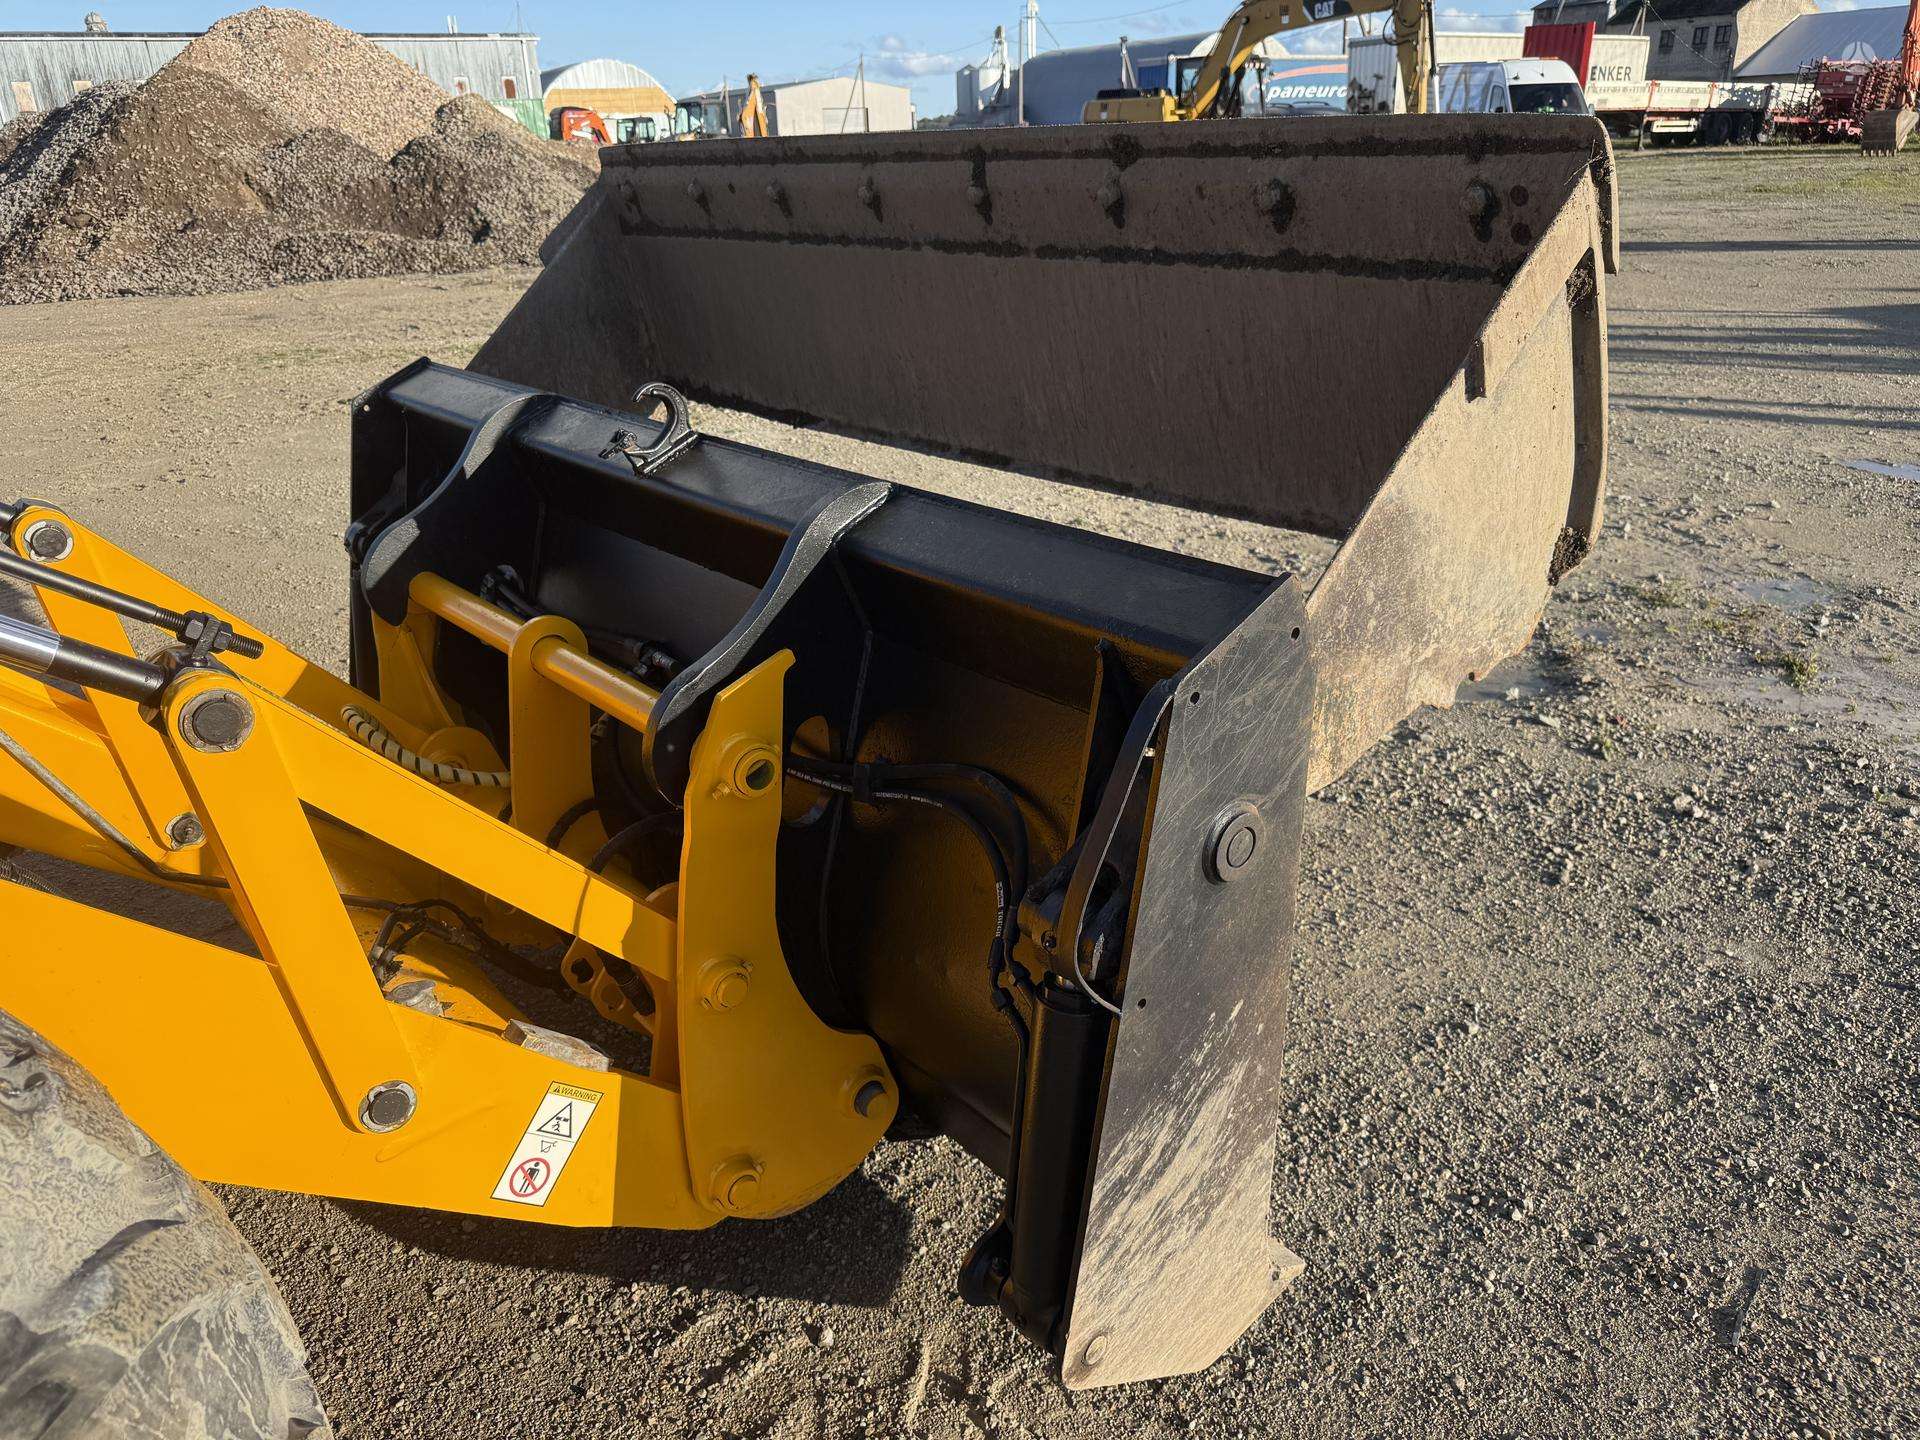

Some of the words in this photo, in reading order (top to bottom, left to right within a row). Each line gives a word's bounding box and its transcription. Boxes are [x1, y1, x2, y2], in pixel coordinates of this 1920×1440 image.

[1314, 1, 1335, 19] CAT
[1590, 66, 1632, 81] ENKER
[561, 1086, 597, 1101] WARNING
